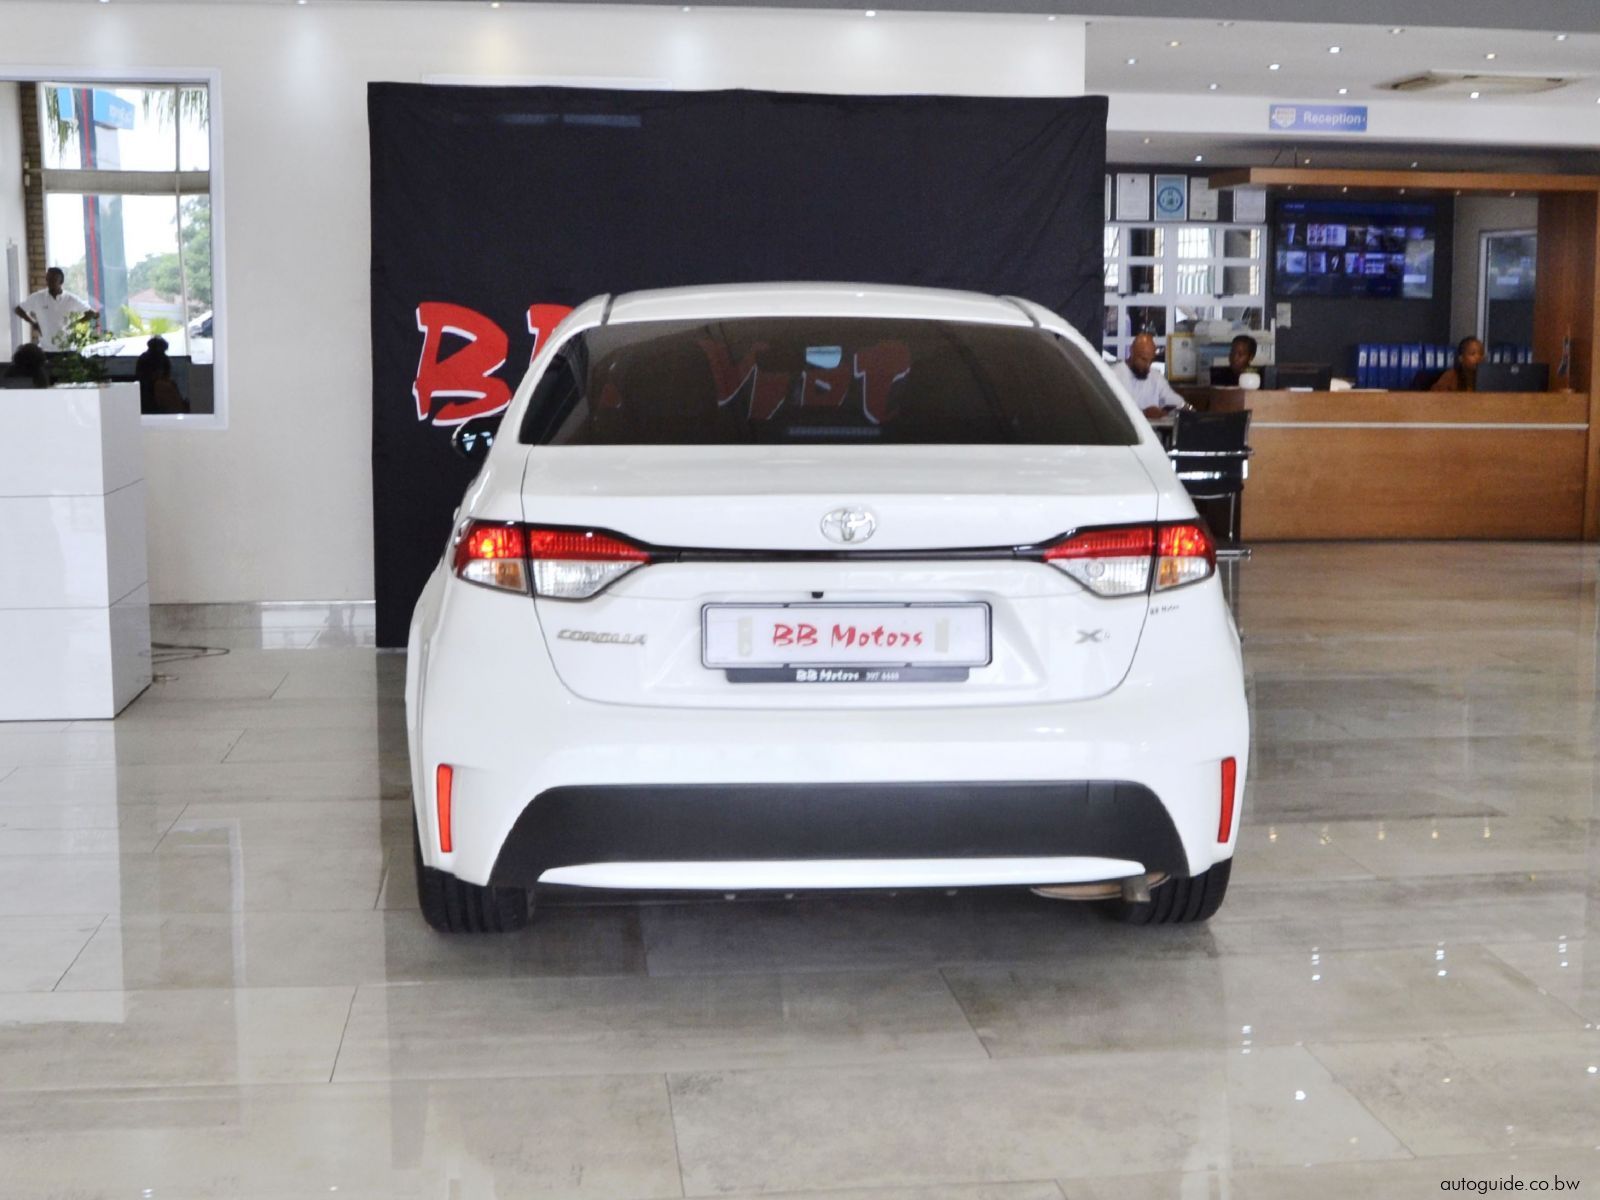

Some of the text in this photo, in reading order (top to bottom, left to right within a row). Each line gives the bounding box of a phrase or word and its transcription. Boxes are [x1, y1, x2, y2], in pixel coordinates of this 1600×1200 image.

[1303, 110, 1361, 127] Reception
[773, 623, 923, 648] BB Motors
[796, 668, 818, 682] BB
